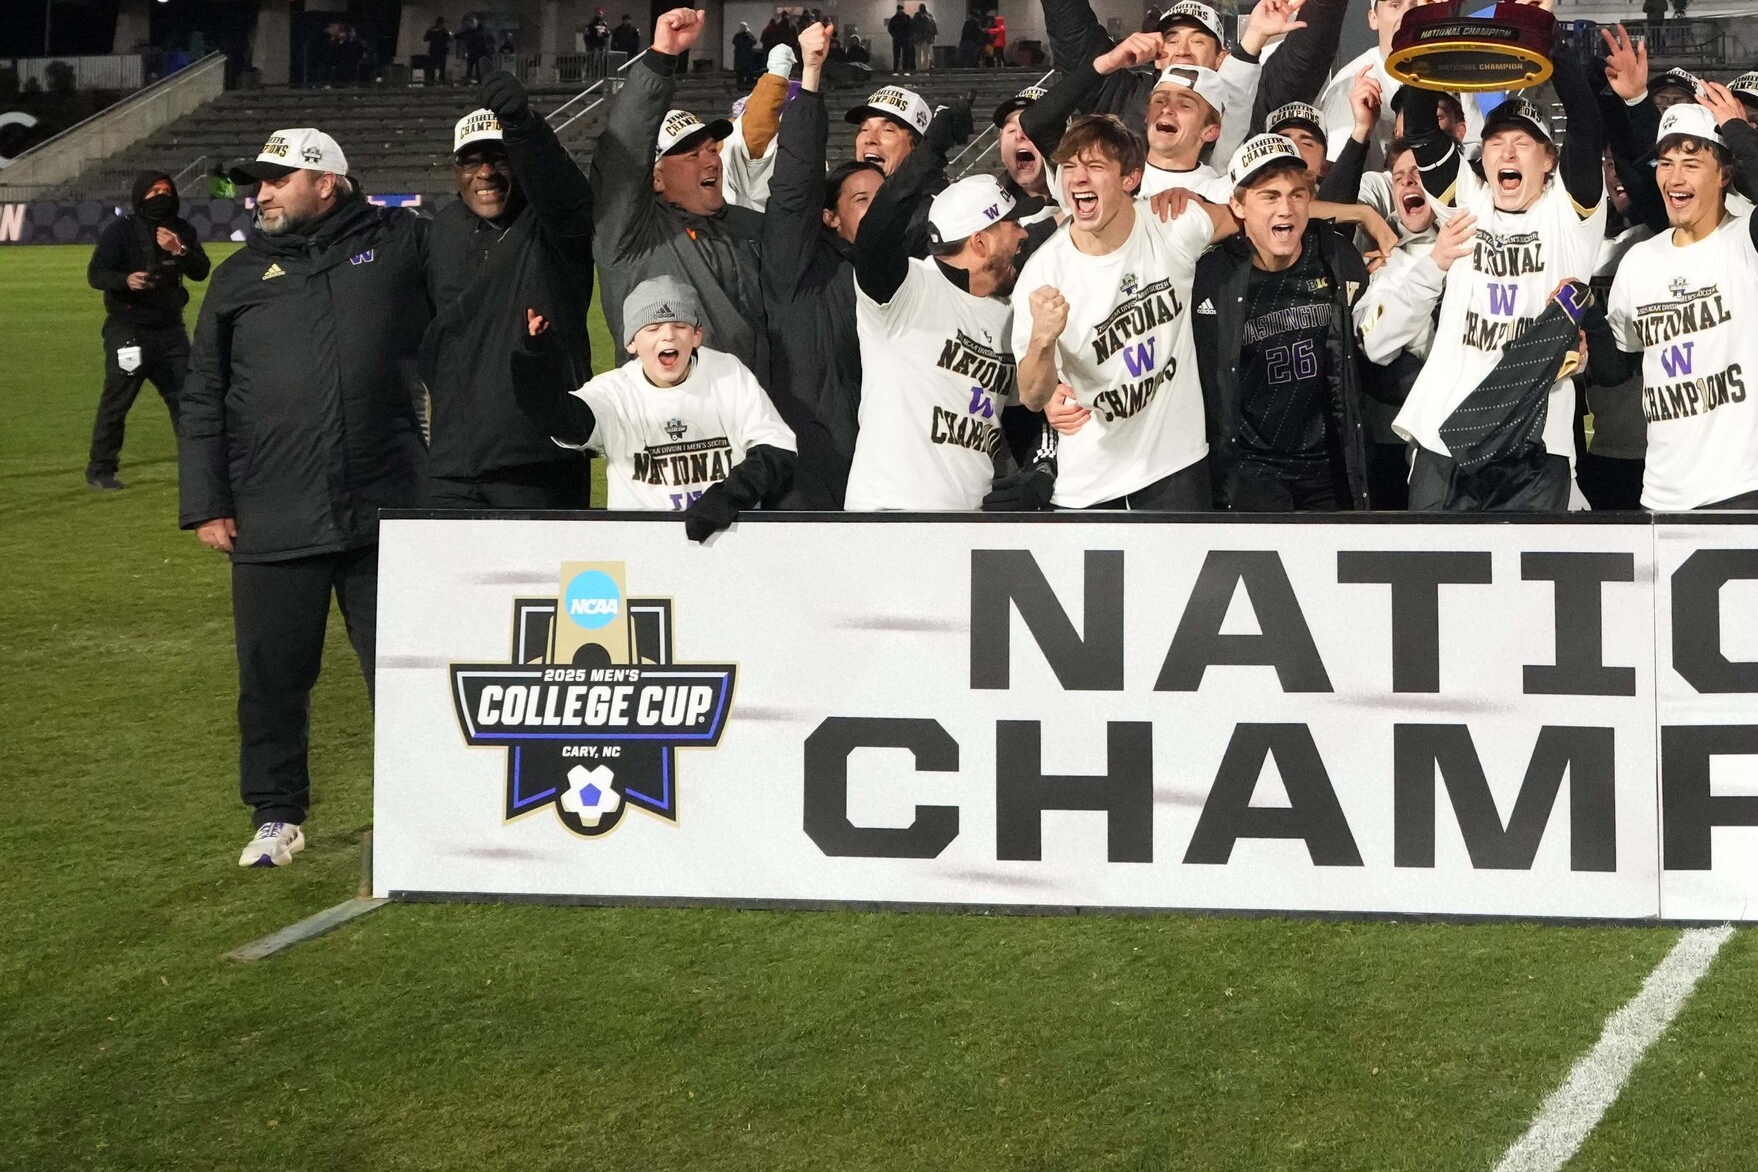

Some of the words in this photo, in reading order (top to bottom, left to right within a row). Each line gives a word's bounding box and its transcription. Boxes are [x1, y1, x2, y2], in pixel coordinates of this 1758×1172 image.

[1420, 27, 1460, 39] NATIONAL
[983, 203, 1000, 220] W
[350, 248, 374, 266] W
[1486, 282, 1518, 316] W
[1122, 335, 1155, 378] W
[1265, 338, 1318, 385] 26
[1661, 341, 1695, 378] W
[686, 442, 707, 451] MEN'S
[570, 598, 618, 615] NCAA
[544, 669, 586, 682] 2025
[590, 669, 640, 682] MEN'S
[477, 685, 634, 726] COLLEGE
[636, 685, 713, 726] CUP
[561, 745, 599, 759] CARY,
[602, 745, 621, 758] NC
